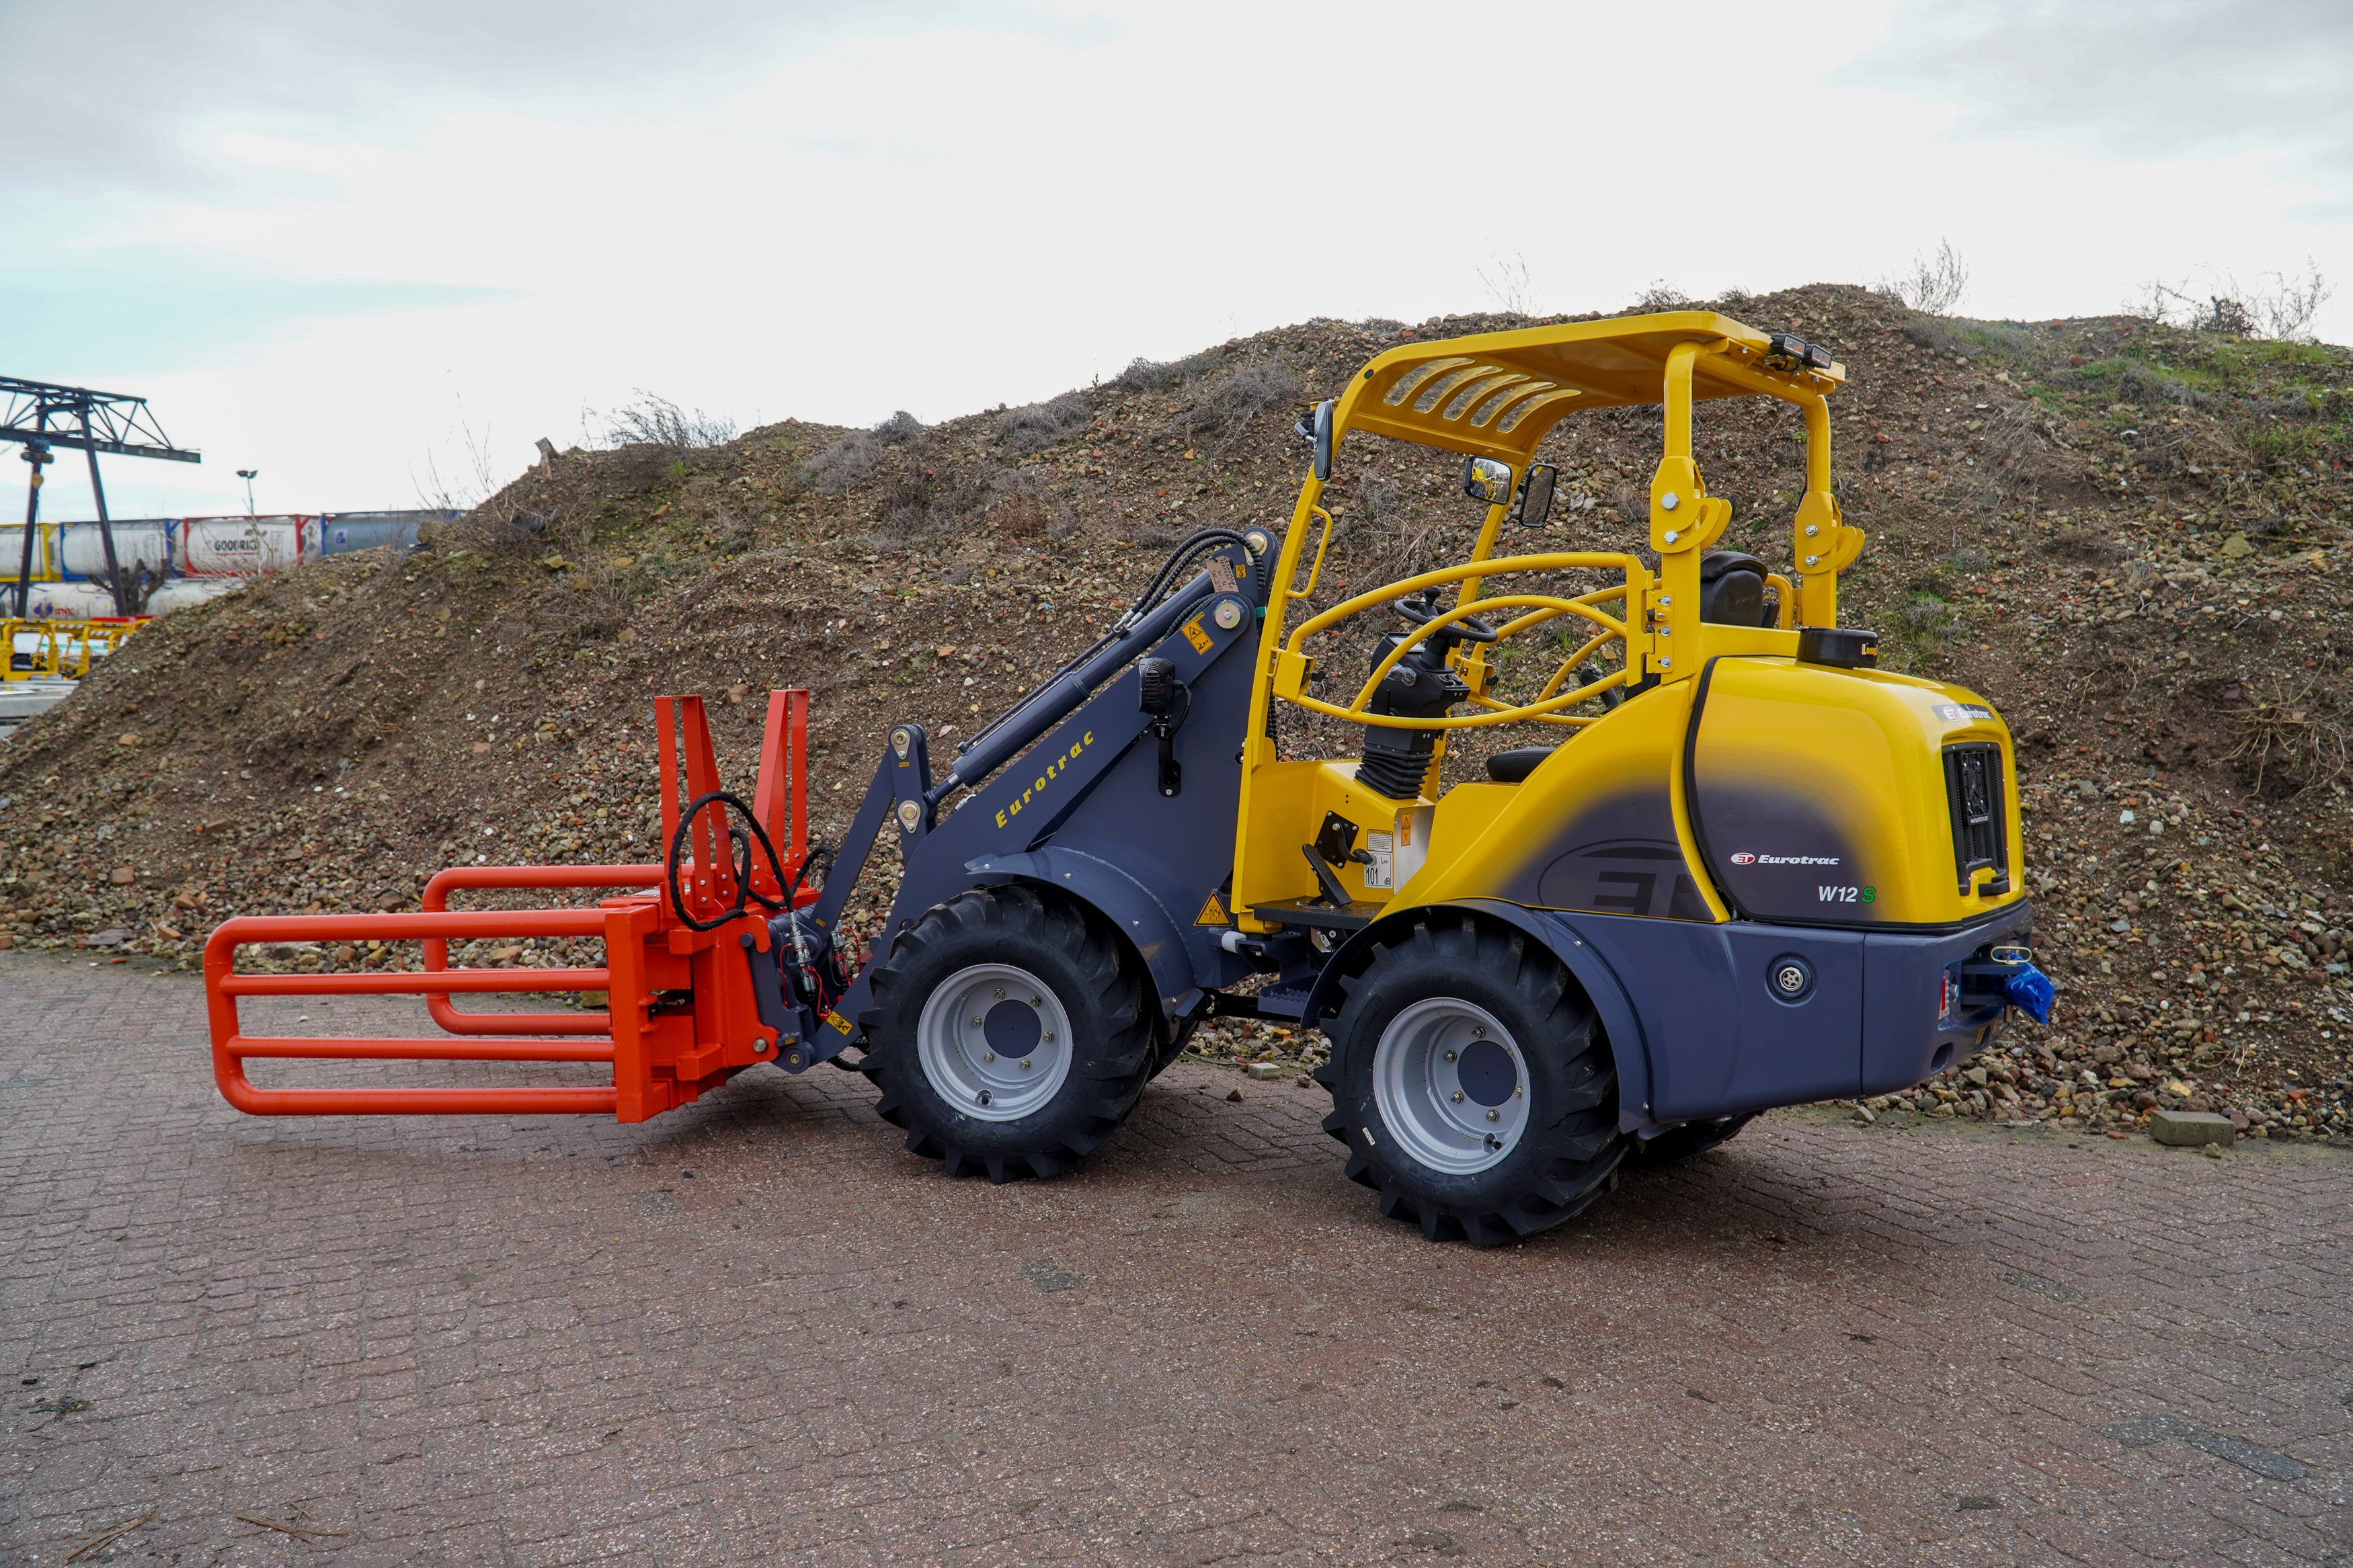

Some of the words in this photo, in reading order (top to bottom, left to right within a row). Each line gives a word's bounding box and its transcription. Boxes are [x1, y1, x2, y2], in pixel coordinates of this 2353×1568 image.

[995, 731, 1094, 829] Eurotrac
[1758, 854, 1839, 865] Eurotrac
[1366, 867, 1378, 884] 101
[1384, 877, 1390, 885] dB
[1819, 886, 1858, 903] W12
[1861, 886, 1876, 903] S
